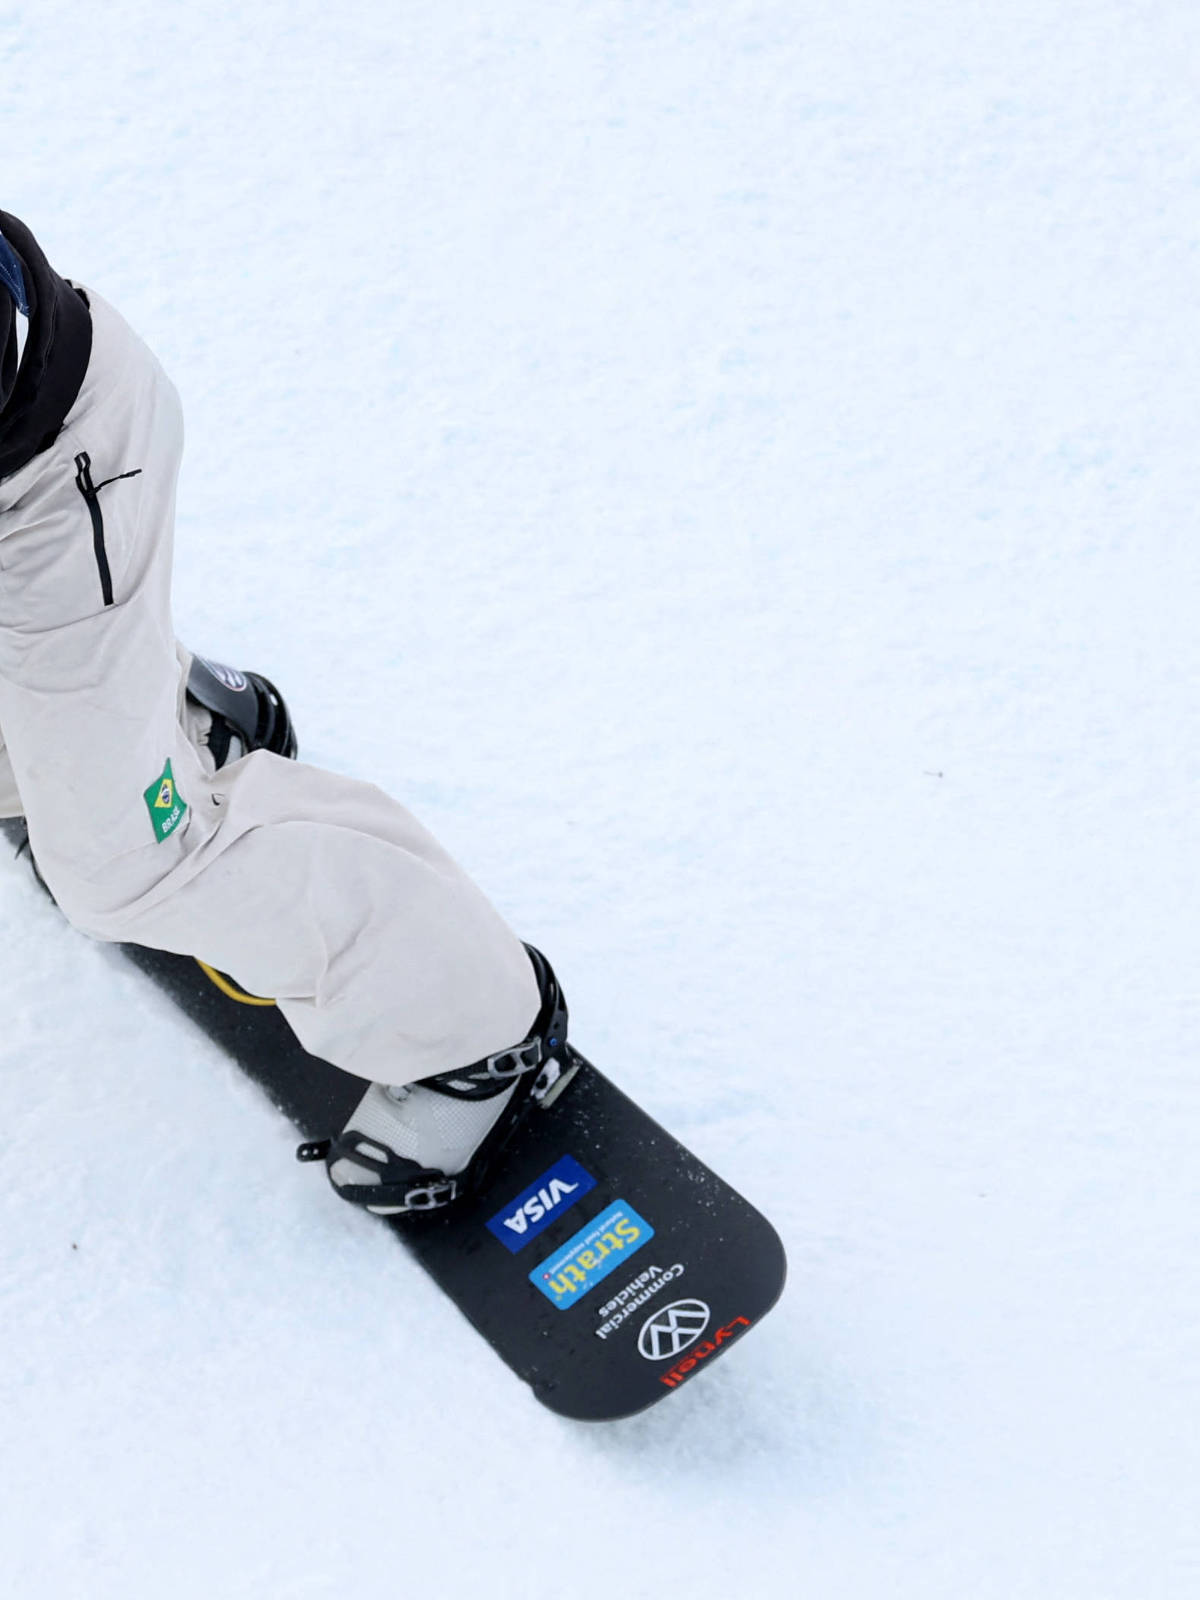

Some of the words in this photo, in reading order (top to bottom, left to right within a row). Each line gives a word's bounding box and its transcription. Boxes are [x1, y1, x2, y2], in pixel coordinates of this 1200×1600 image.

[503, 1178, 579, 1234] VISA
[548, 1218, 640, 1294] Strath
[595, 1263, 685, 1340] Commercial
[599, 1265, 663, 1318] Vehicles
[660, 1317, 750, 1387] Lynell
